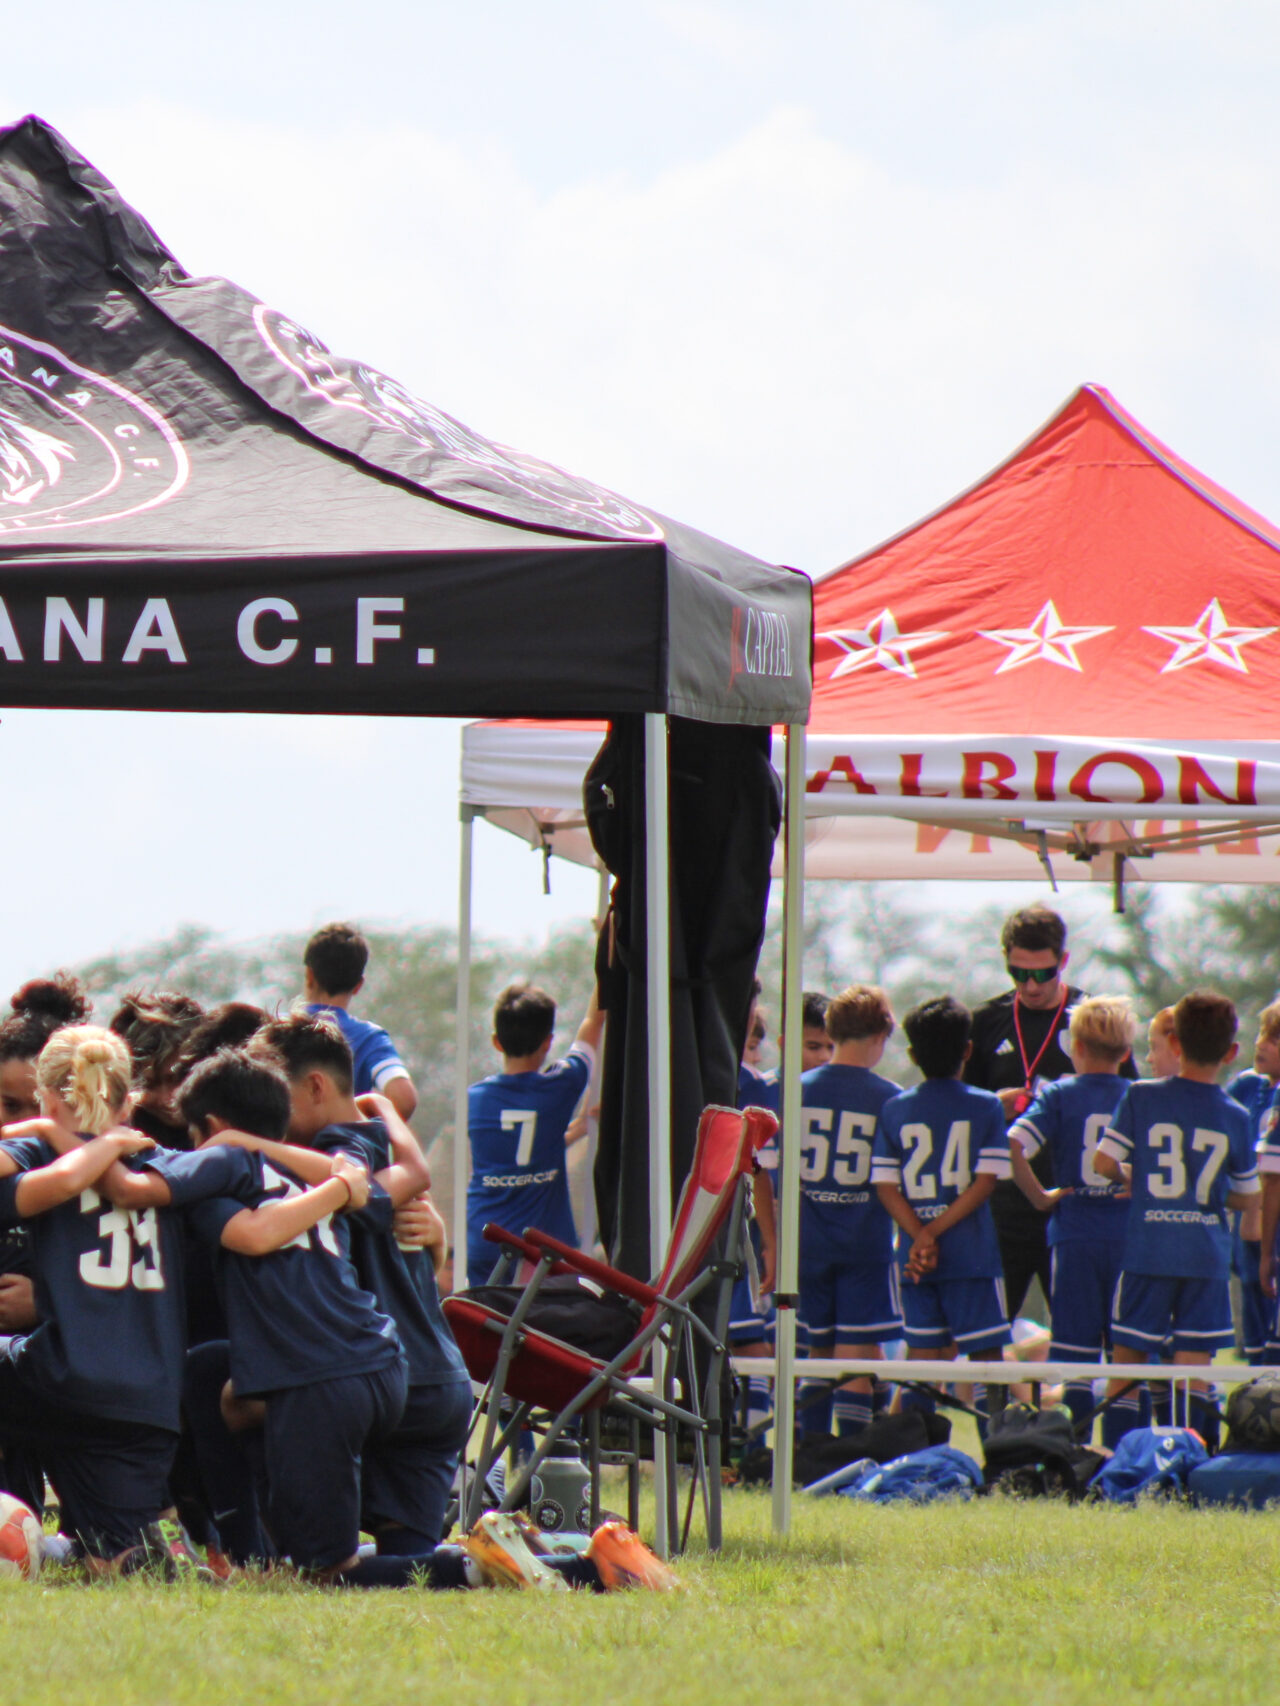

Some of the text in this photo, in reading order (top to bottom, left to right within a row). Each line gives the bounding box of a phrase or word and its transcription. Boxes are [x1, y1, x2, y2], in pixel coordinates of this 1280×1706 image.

[235, 596, 436, 665] C.F.
[745, 607, 793, 677] CAPITAL
[804, 750, 1258, 806] ALBION
[500, 1109, 538, 1167] 7
[799, 1107, 877, 1186] 55
[900, 1120, 971, 1199] 24
[1148, 1123, 1229, 1205] 37
